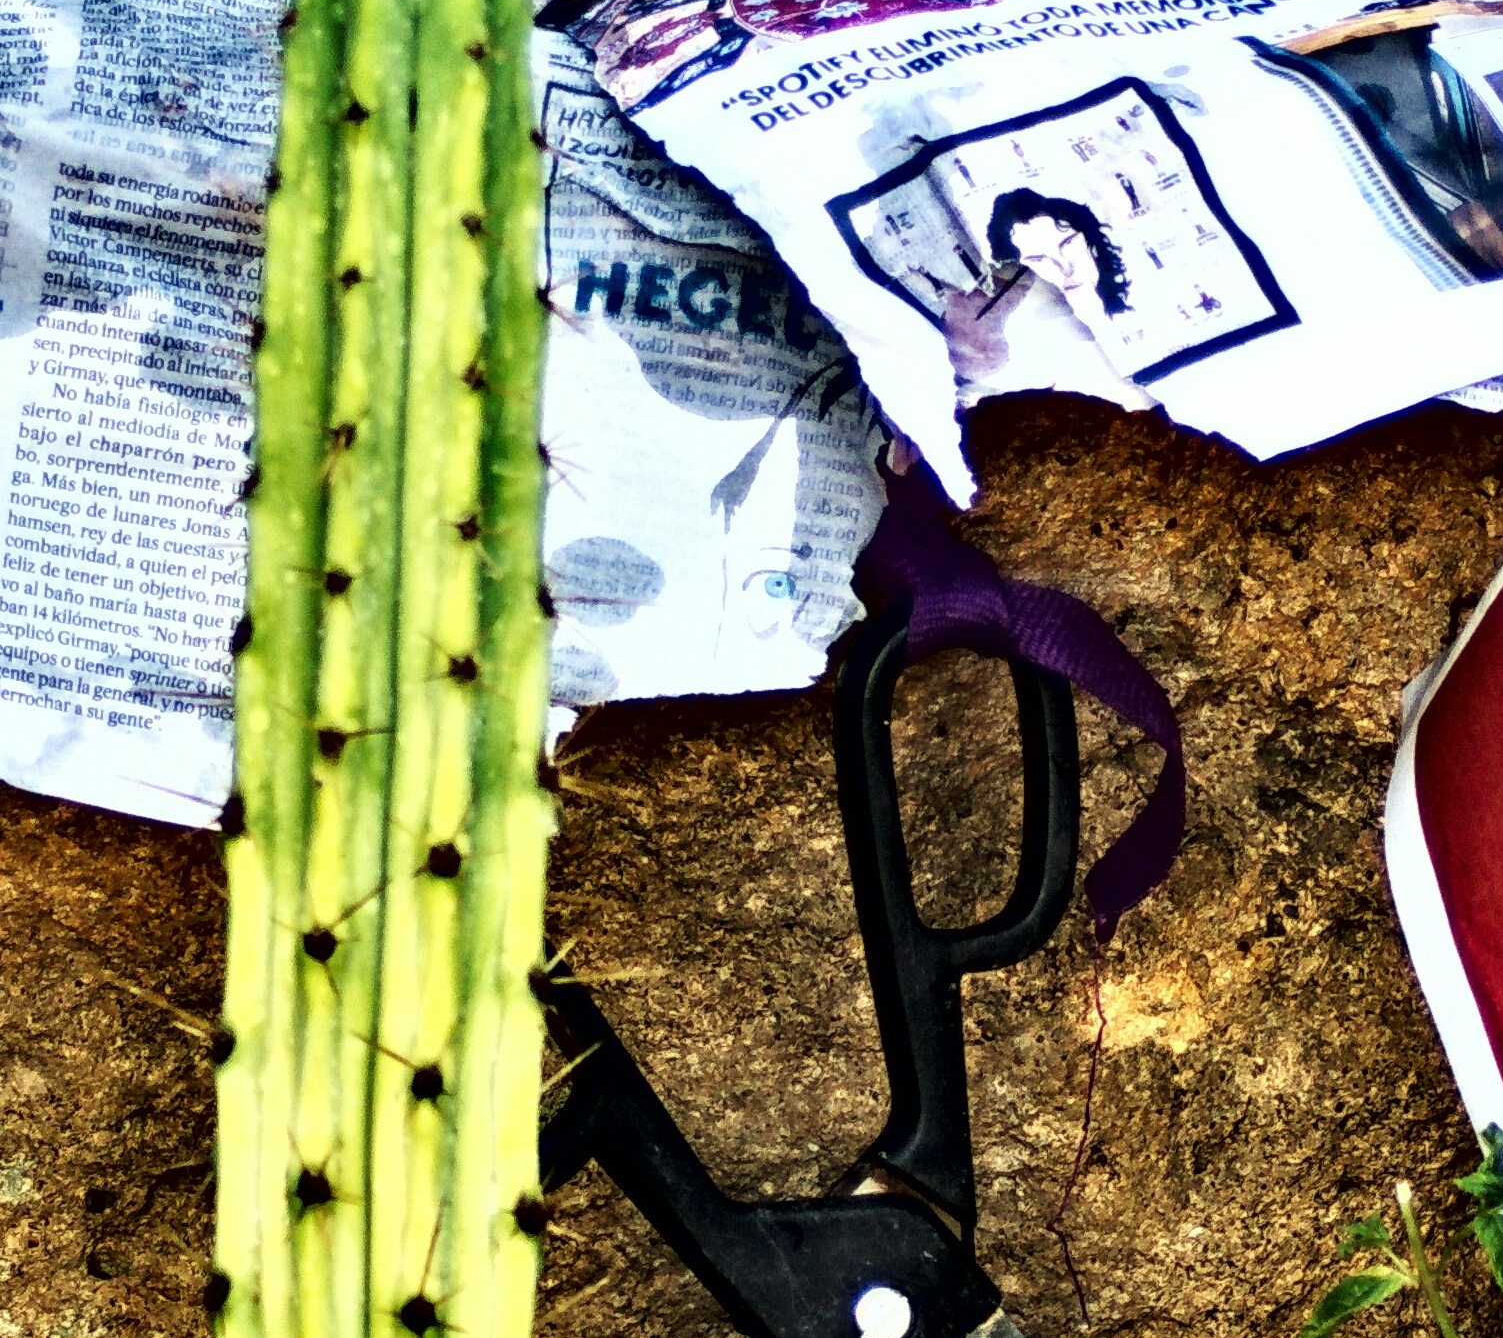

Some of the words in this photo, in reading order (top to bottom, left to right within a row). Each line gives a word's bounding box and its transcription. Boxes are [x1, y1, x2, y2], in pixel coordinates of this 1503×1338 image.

[721, 47, 864, 112] “SPOTIFY
[867, 17, 1004, 64] ELIMINÓ
[1004, 0, 1095, 35] TODA
[750, 100, 811, 133] DEL
[808, 23, 1084, 110] DESCUBRIMIENTO
[1089, 22, 1127, 41] DE
[1126, 13, 1200, 39] UNA
[575, 259, 822, 355] HEGEL
[9, 490, 82, 519] noruego
[86, 499, 108, 520] de
[113, 504, 177, 530] lunares
[182, 518, 232, 540] Jonas
[5, 532, 121, 568] combatividad,
[126, 557, 135, 569] a
[140, 556, 188, 578] quien
[192, 564, 208, 582] el
[57, 631, 121, 658] Girmay,
[74, 704, 84, 717] a
[87, 704, 104, 721] su
